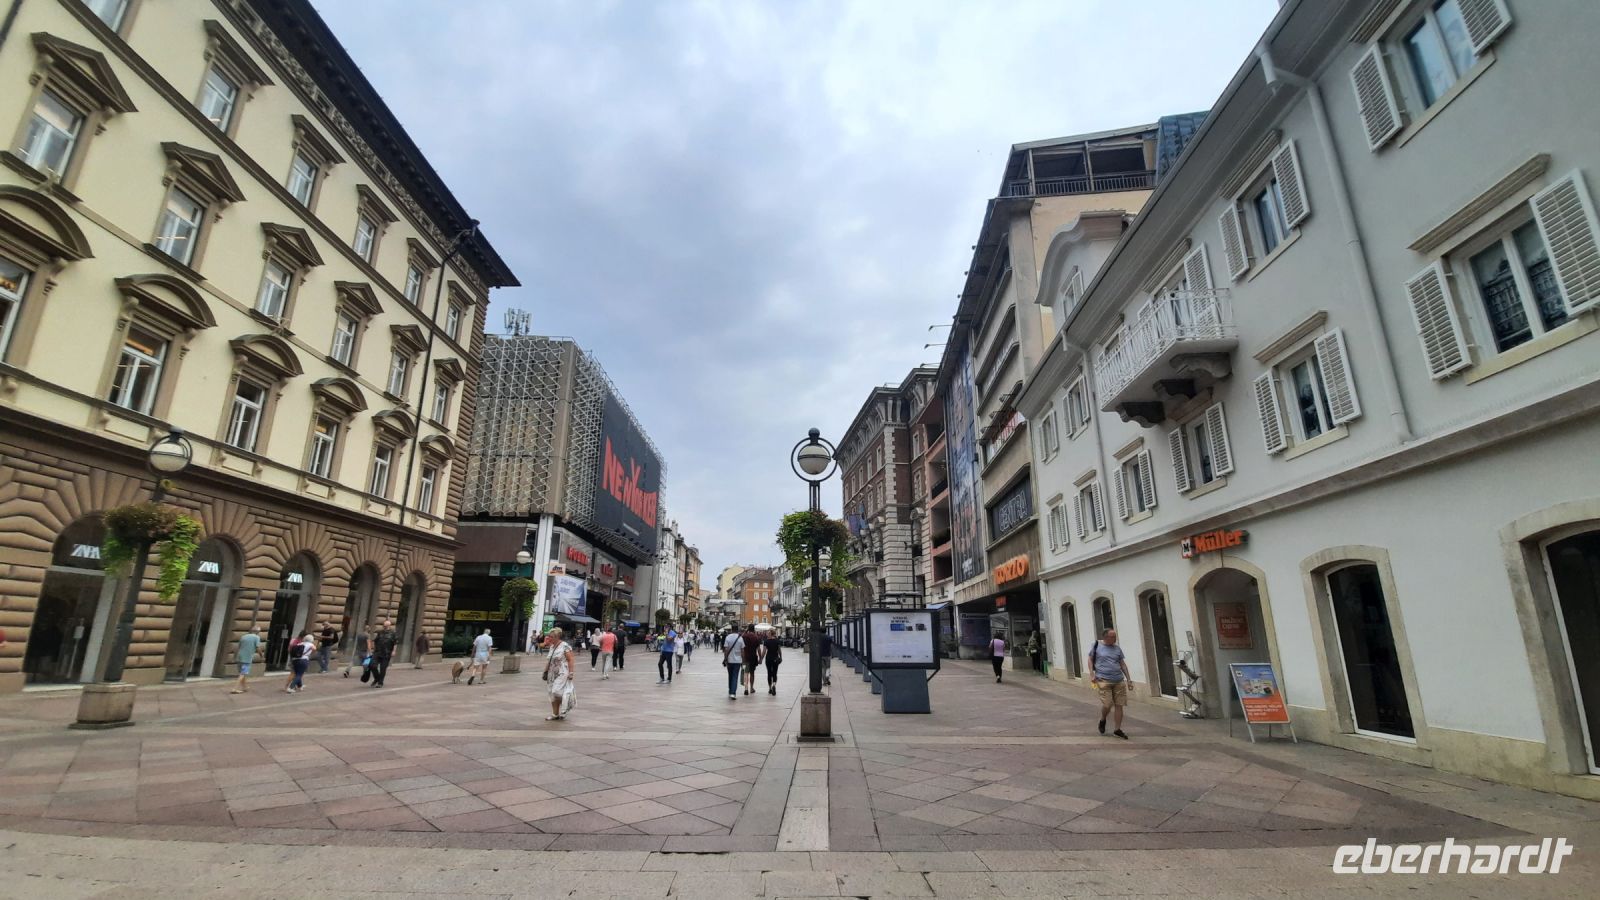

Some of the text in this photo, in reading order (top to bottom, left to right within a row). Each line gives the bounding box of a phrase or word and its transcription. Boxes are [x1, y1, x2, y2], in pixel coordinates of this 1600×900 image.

[1195, 529, 1243, 553] Müller
[70, 544, 101, 559] ZARA
[198, 561, 219, 574] ZARA
[288, 572, 302, 583] ZARA
